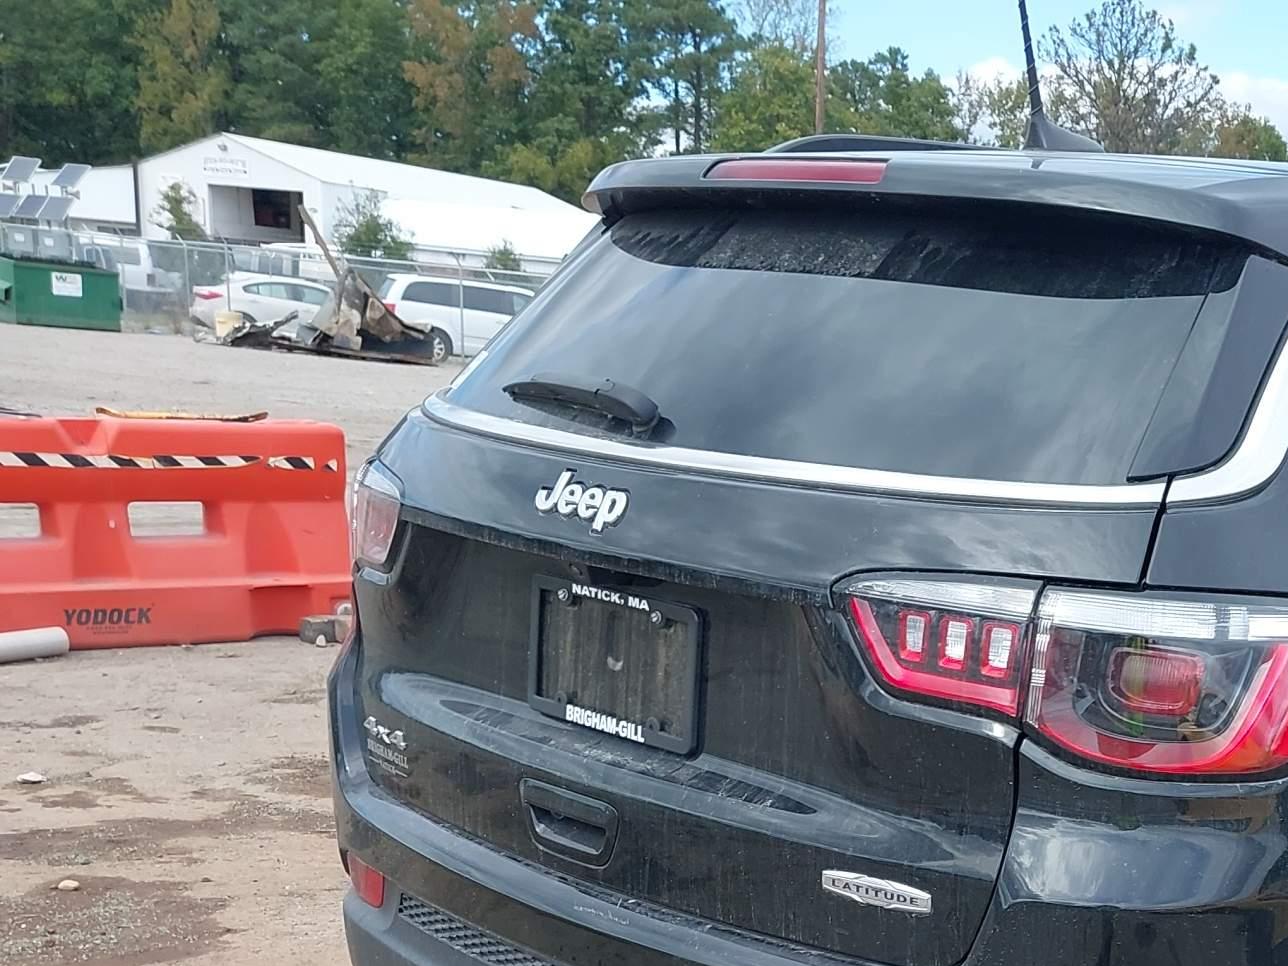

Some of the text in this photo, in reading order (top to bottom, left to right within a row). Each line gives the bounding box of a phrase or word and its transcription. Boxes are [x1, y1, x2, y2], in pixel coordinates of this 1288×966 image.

[535, 469, 628, 533] Jeep
[571, 583, 650, 612] NATICK, MA
[63, 607, 151, 626] YODOCK
[565, 704, 645, 743] BRIGHAM-GILL
[831, 878, 920, 906] LATITUDE
